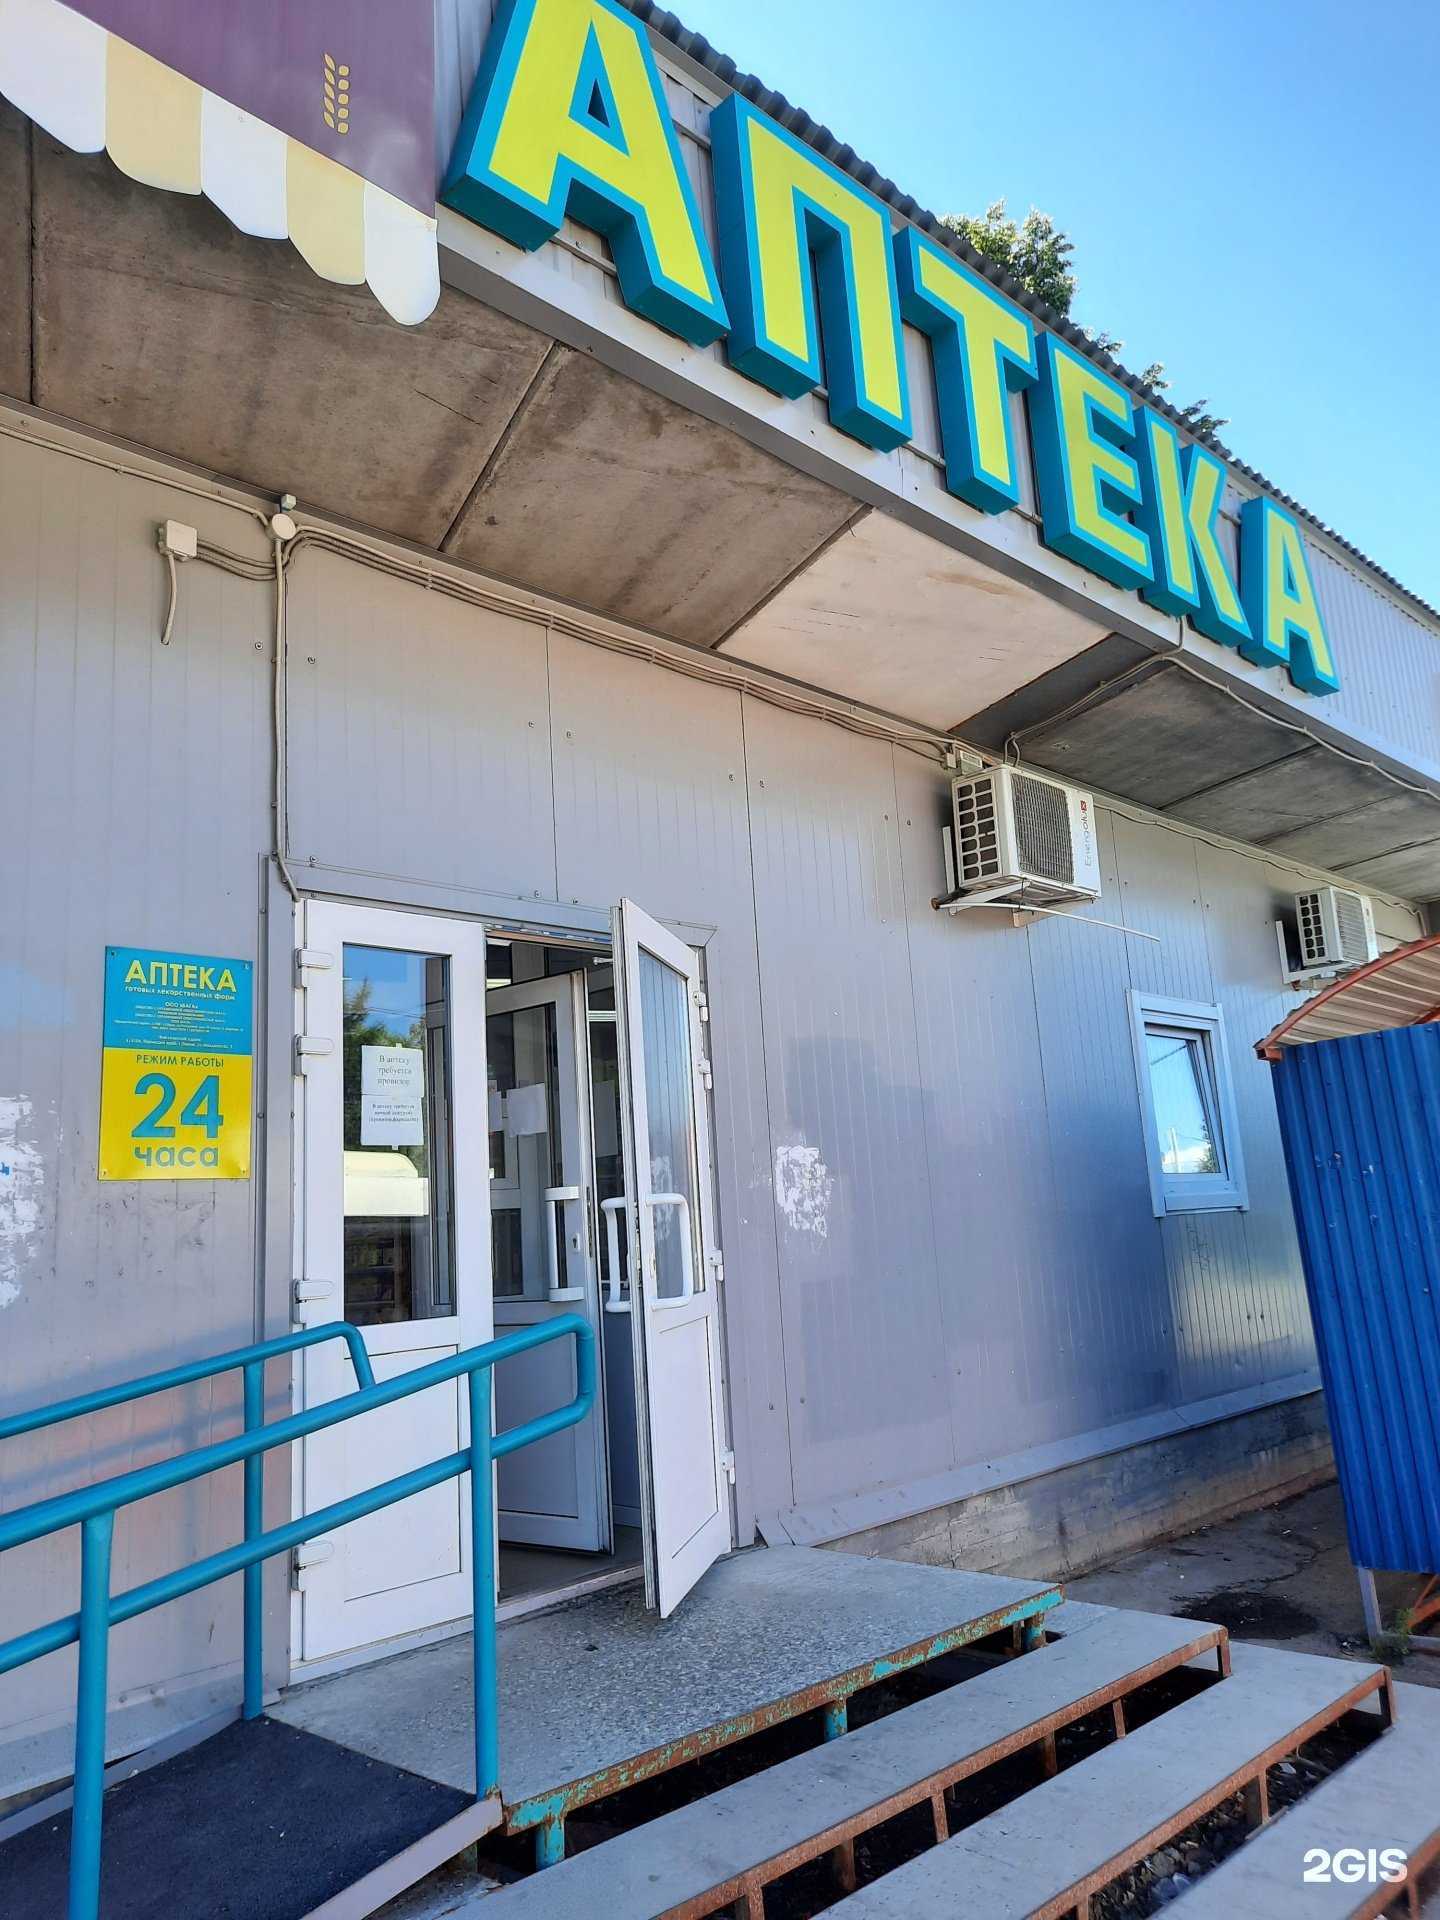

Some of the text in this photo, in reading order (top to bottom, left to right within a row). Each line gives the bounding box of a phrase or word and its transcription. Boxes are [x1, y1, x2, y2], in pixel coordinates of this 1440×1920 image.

[444, 0, 1340, 697] АПТЕКА
[125, 959, 237, 992] АПТЕКА
[136, 1054, 224, 1067] РЕЖИМ РАБОТЫ
[131, 1072, 224, 1138] 24
[134, 1146, 219, 1167] часа
